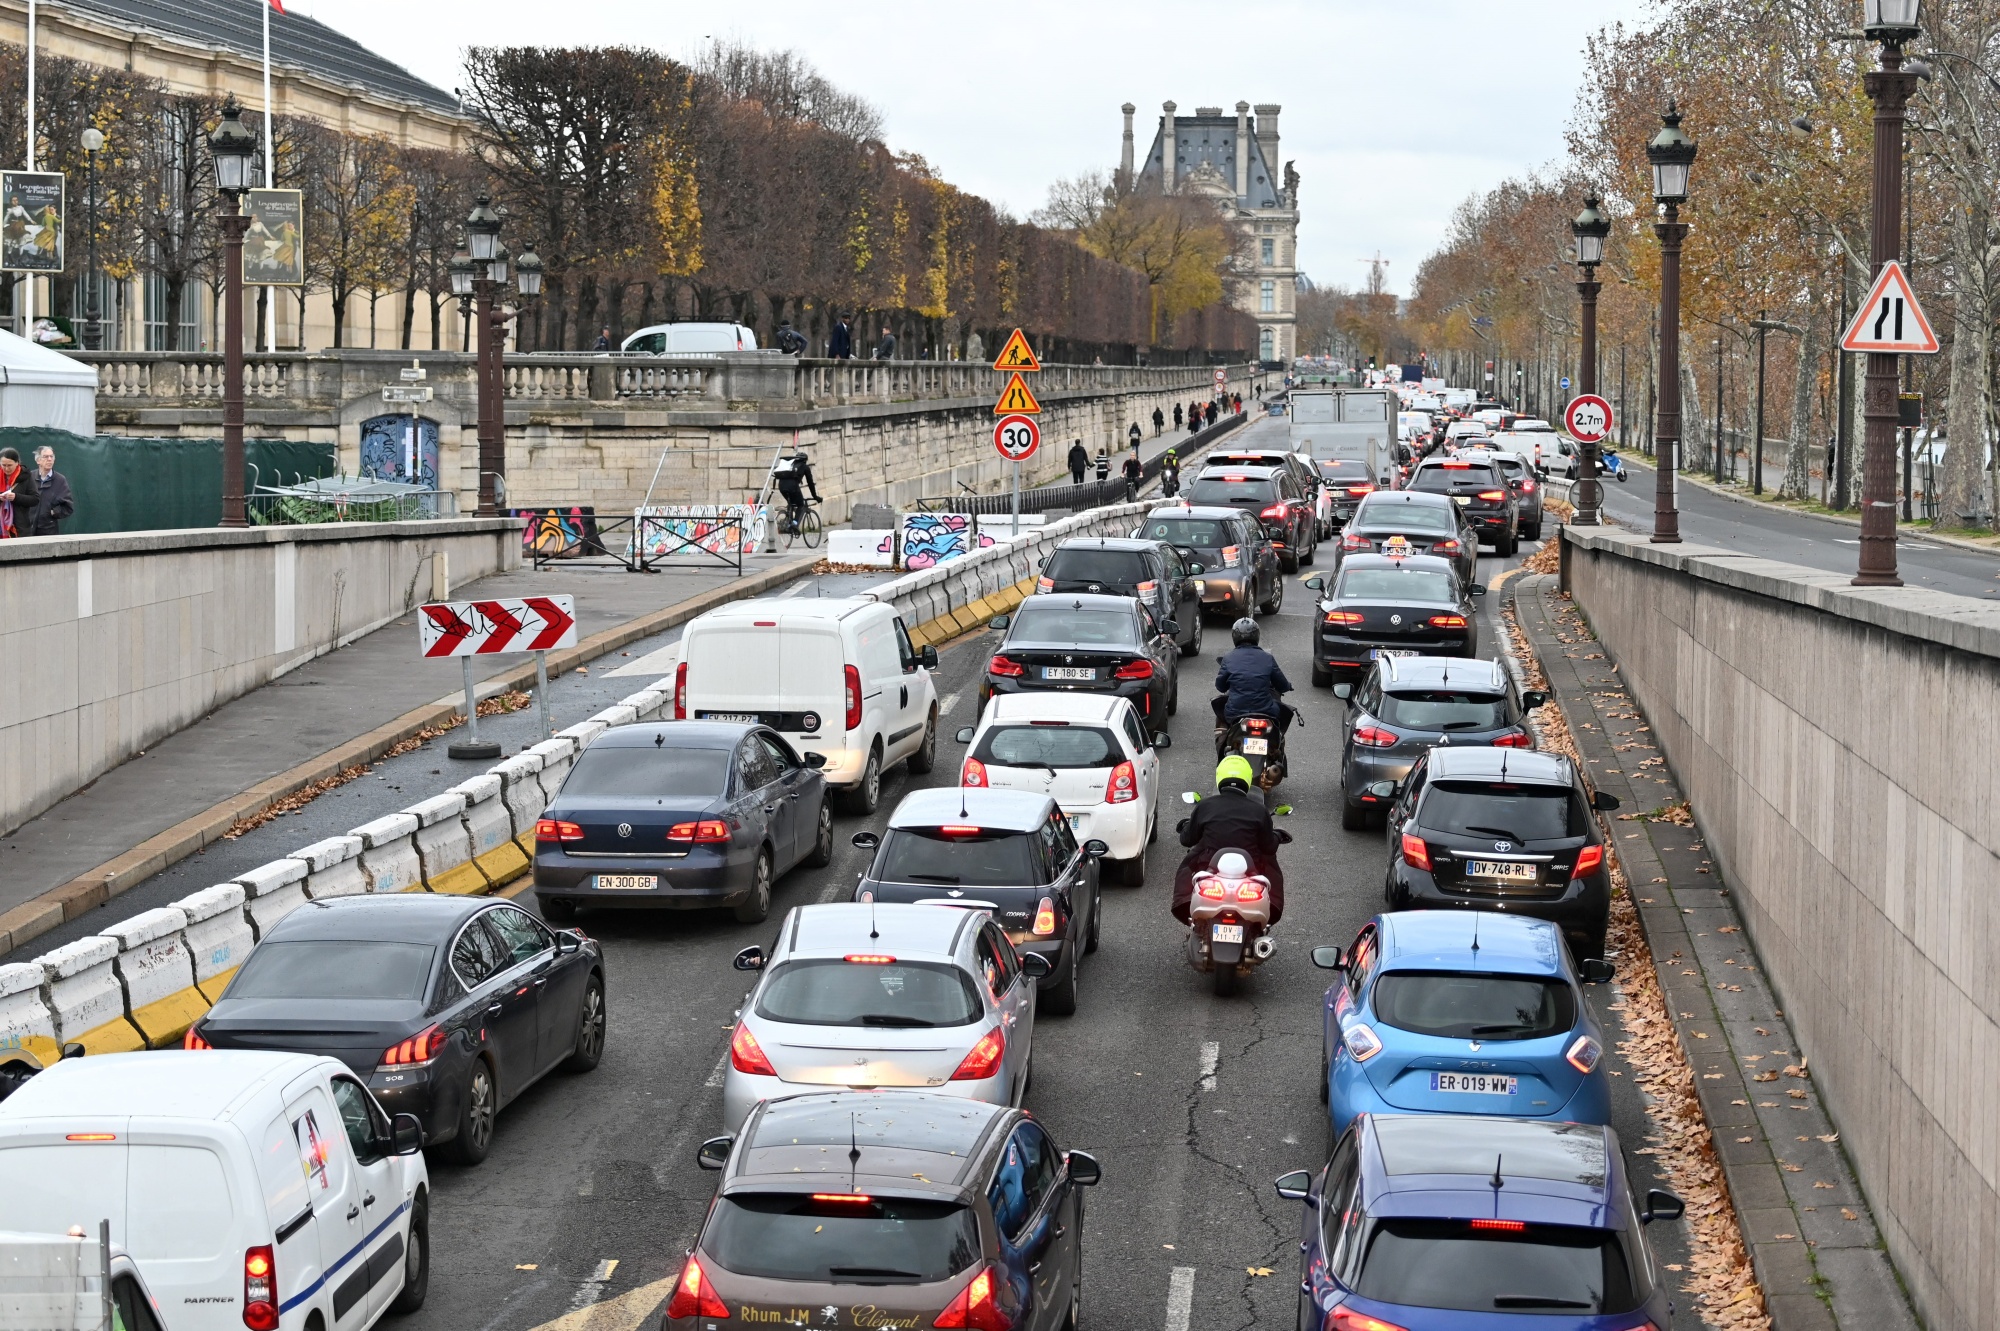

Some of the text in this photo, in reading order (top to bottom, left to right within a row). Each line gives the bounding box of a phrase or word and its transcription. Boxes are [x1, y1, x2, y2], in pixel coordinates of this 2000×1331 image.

[1575, 413, 1603, 425] 2.7m
[1004, 428, 1031, 448] 30
[1474, 862, 1526, 876] DV-748-RL
[600, 877, 650, 887] EN-300-GB
[1440, 1076, 1508, 1092] ER-019-WW
[741, 1306, 781, 1322] Rhum
